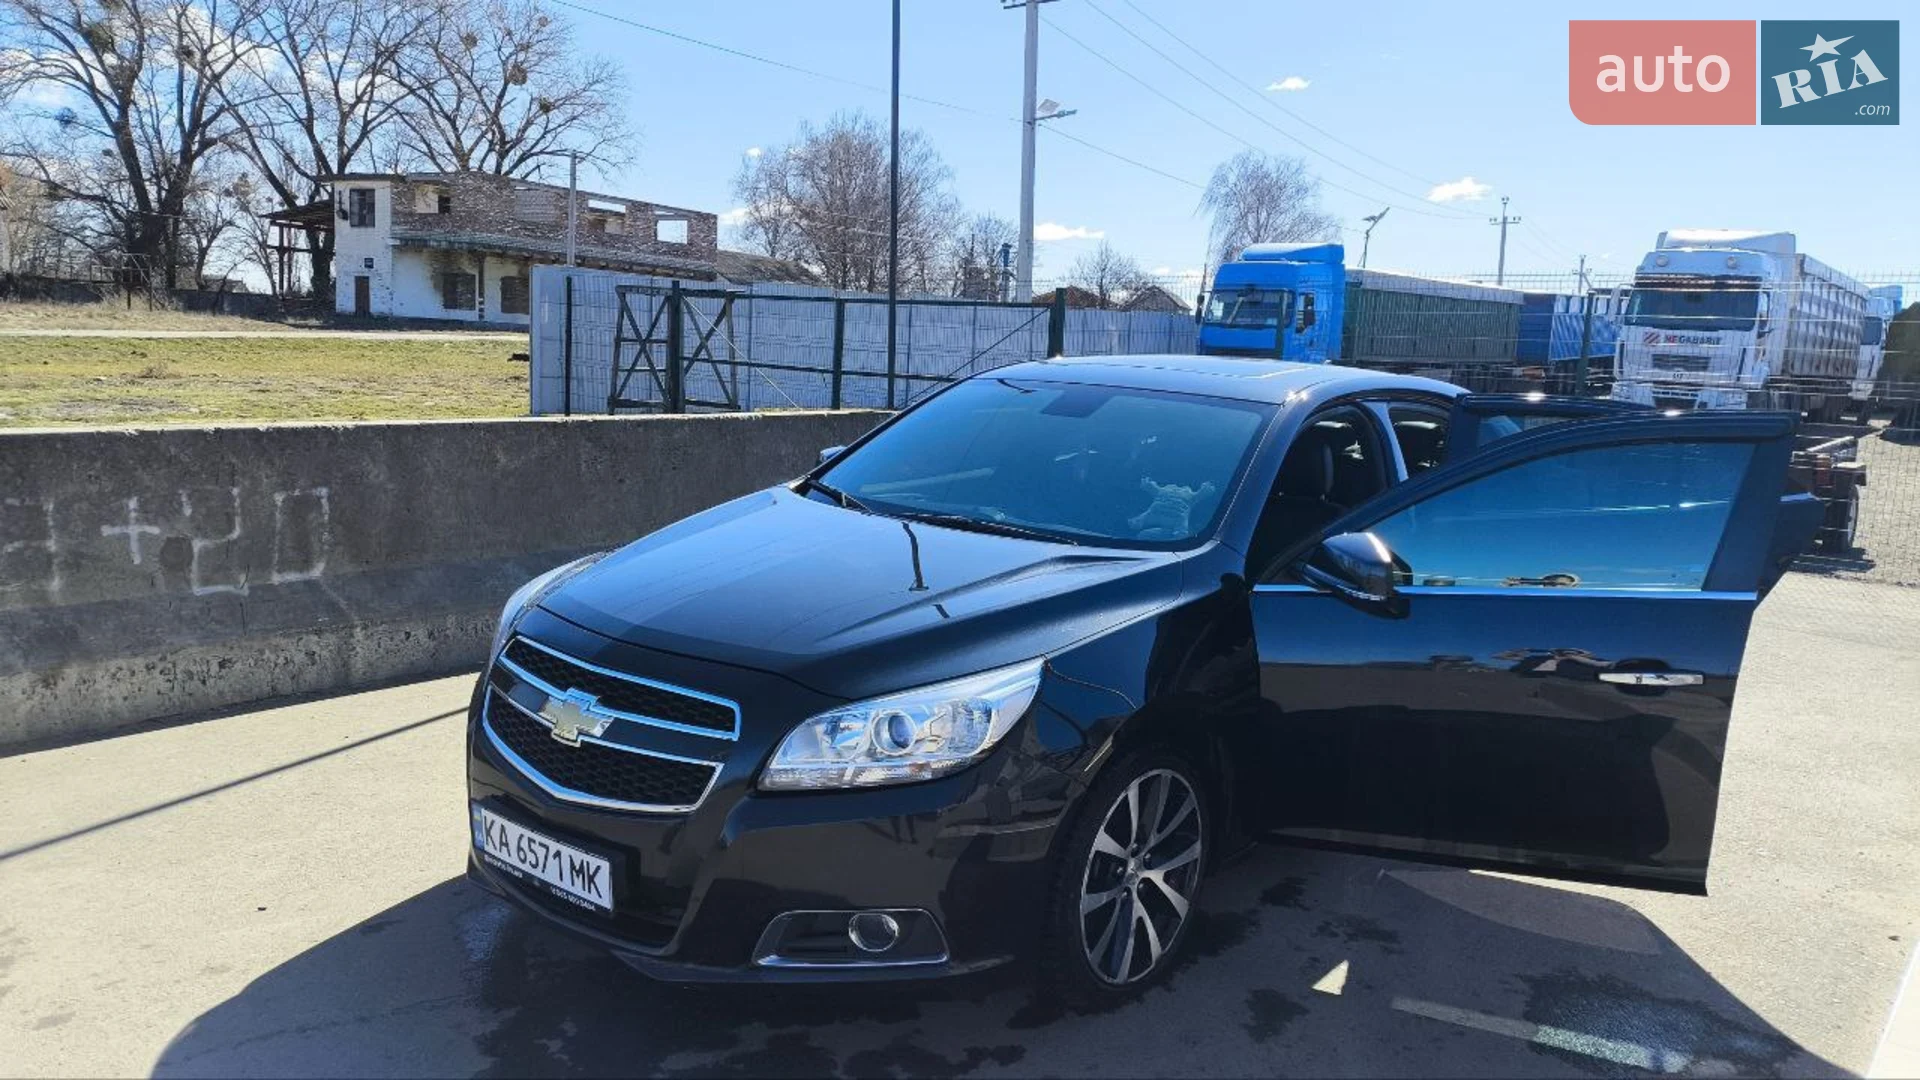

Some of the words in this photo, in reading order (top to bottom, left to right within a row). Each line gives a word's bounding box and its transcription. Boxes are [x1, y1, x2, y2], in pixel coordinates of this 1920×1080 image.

[483, 815, 511, 858] KA
[516, 833, 564, 883] 6571
[568, 854, 603, 899] MK
